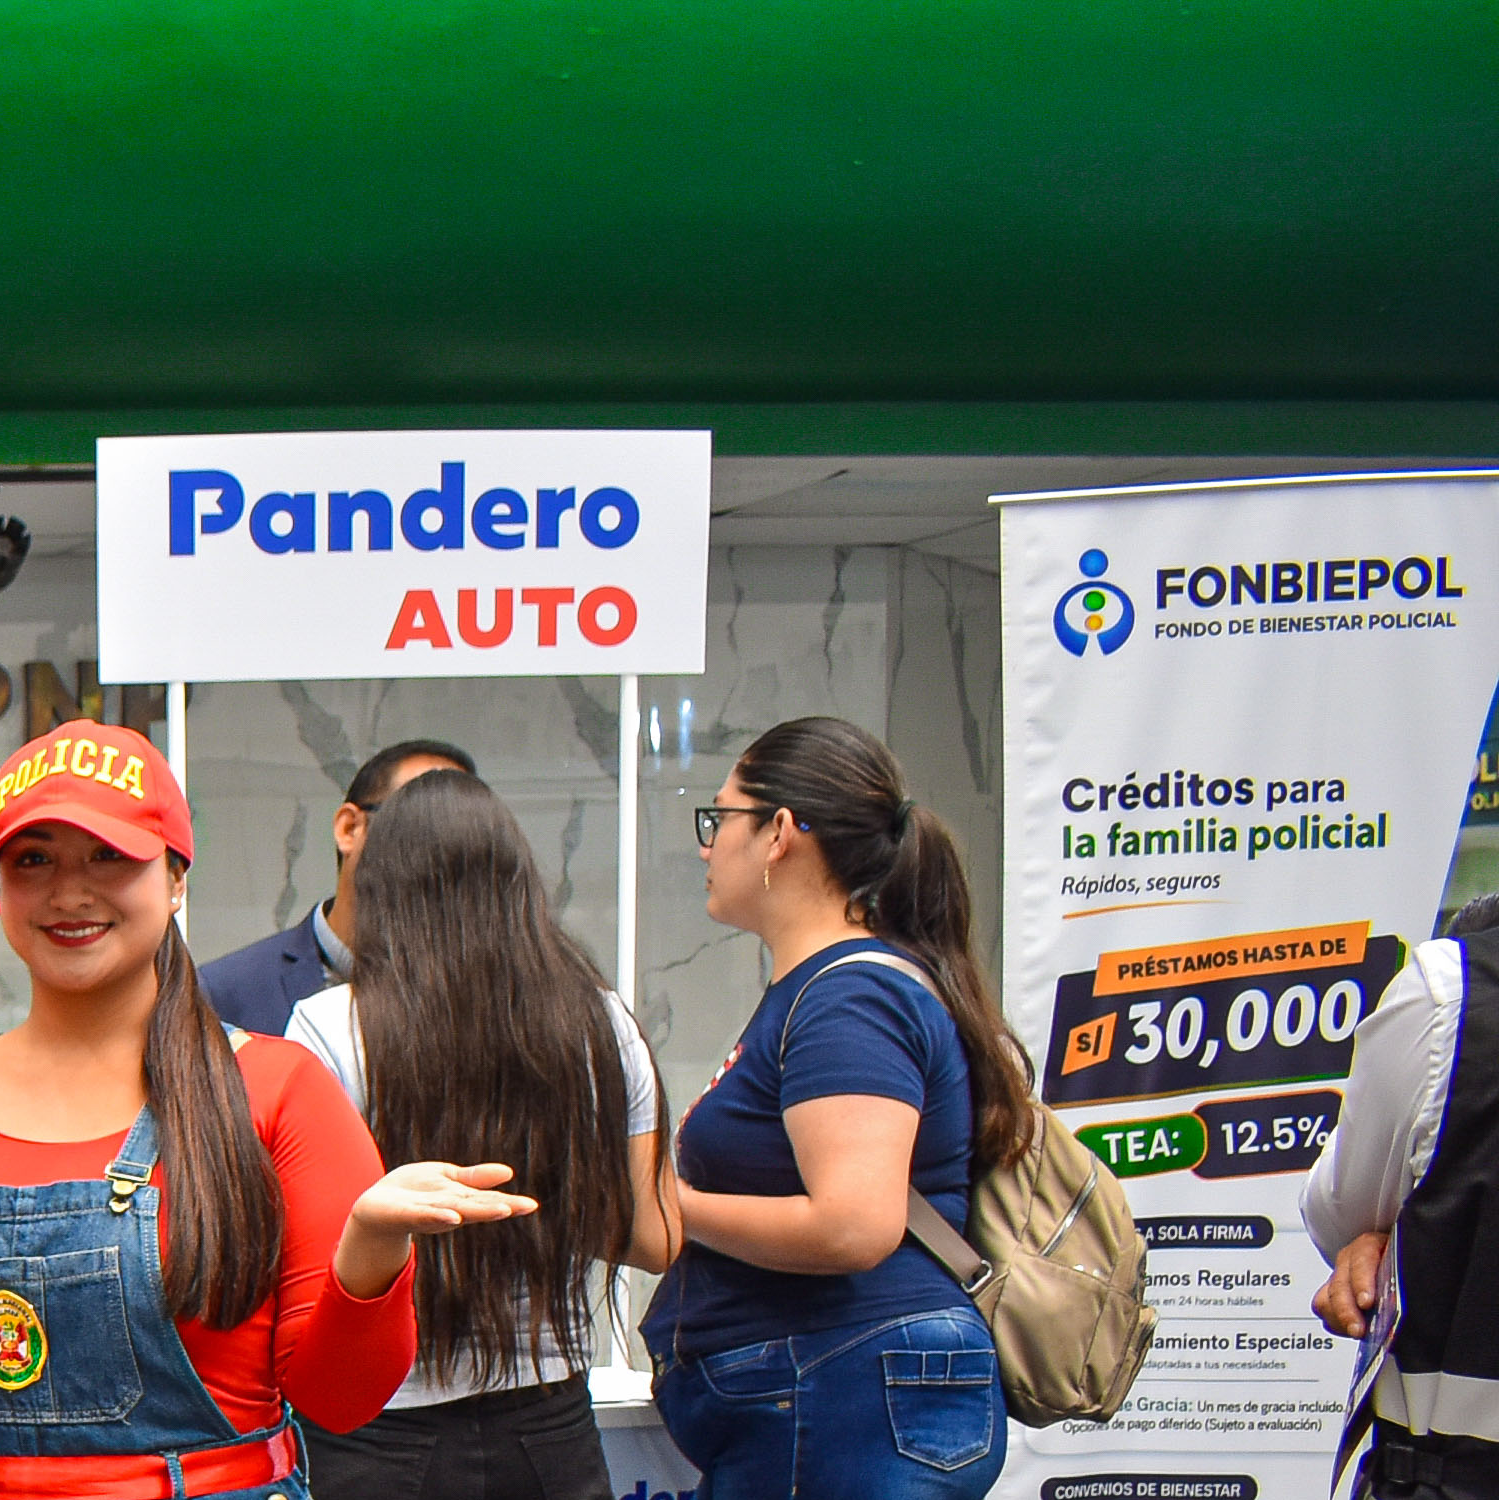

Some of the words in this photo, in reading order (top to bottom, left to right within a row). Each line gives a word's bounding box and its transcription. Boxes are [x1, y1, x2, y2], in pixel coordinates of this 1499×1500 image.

[169, 460, 640, 556] Pandero
[1155, 556, 1465, 610] FONBIEPOL
[384, 586, 638, 650] AUTO
[1155, 620, 1222, 639] FONDO
[1229, 619, 1253, 635] DE
[1260, 615, 1363, 634] BIENESTAR
[1369, 612, 1456, 629] POLICIAL
[1062, 769, 1254, 813] Créditos
[1267, 779, 1345, 811] para
[1063, 825, 1095, 859] la
[1108, 816, 1237, 857] familia
[1248, 813, 1388, 860] policial
[1061, 874, 1141, 898] Rápidos,
[1146, 873, 1221, 894] seguros
[1118, 950, 1239, 980] PRÉSTAMOS
[1243, 942, 1315, 965] HASTA
[1320, 938, 1348, 957] DE
[1076, 1024, 1105, 1057] S/
[1124, 980, 1364, 1068] 30,000
[1103, 1128, 1181, 1165] TEA:
[1222, 1117, 1330, 1156] 12.5%
[1158, 1225, 1199, 1241] SOLA
[1203, 1225, 1254, 1240] FIRMA
[1198, 1269, 1291, 1291] Regulares
[1195, 1296, 1224, 1306] horas
[1227, 1296, 1265, 1306] hábiles
[1235, 1332, 1334, 1354] Especiales
[1222, 1360, 1286, 1370] necesidades
[1137, 1396, 1193, 1413] Gracia:
[1197, 1400, 1214, 1412] Un
[1216, 1402, 1242, 1413] mes
[1243, 1401, 1259, 1413] de
[1261, 1401, 1296, 1416] gracia
[1111, 1418, 1125, 1430] de
[1127, 1420, 1156, 1432] pago
[1159, 1418, 1202, 1430] diferido
[1204, 1418, 1245, 1433] (Sujeto
[1248, 1421, 1255, 1431] a
[1257, 1418, 1322, 1432] evaluación)
[1055, 1482, 1133, 1500] CONVENIOS
[1137, 1483, 1156, 1497] DE
[1160, 1483, 1241, 1498] BIENESTAR
